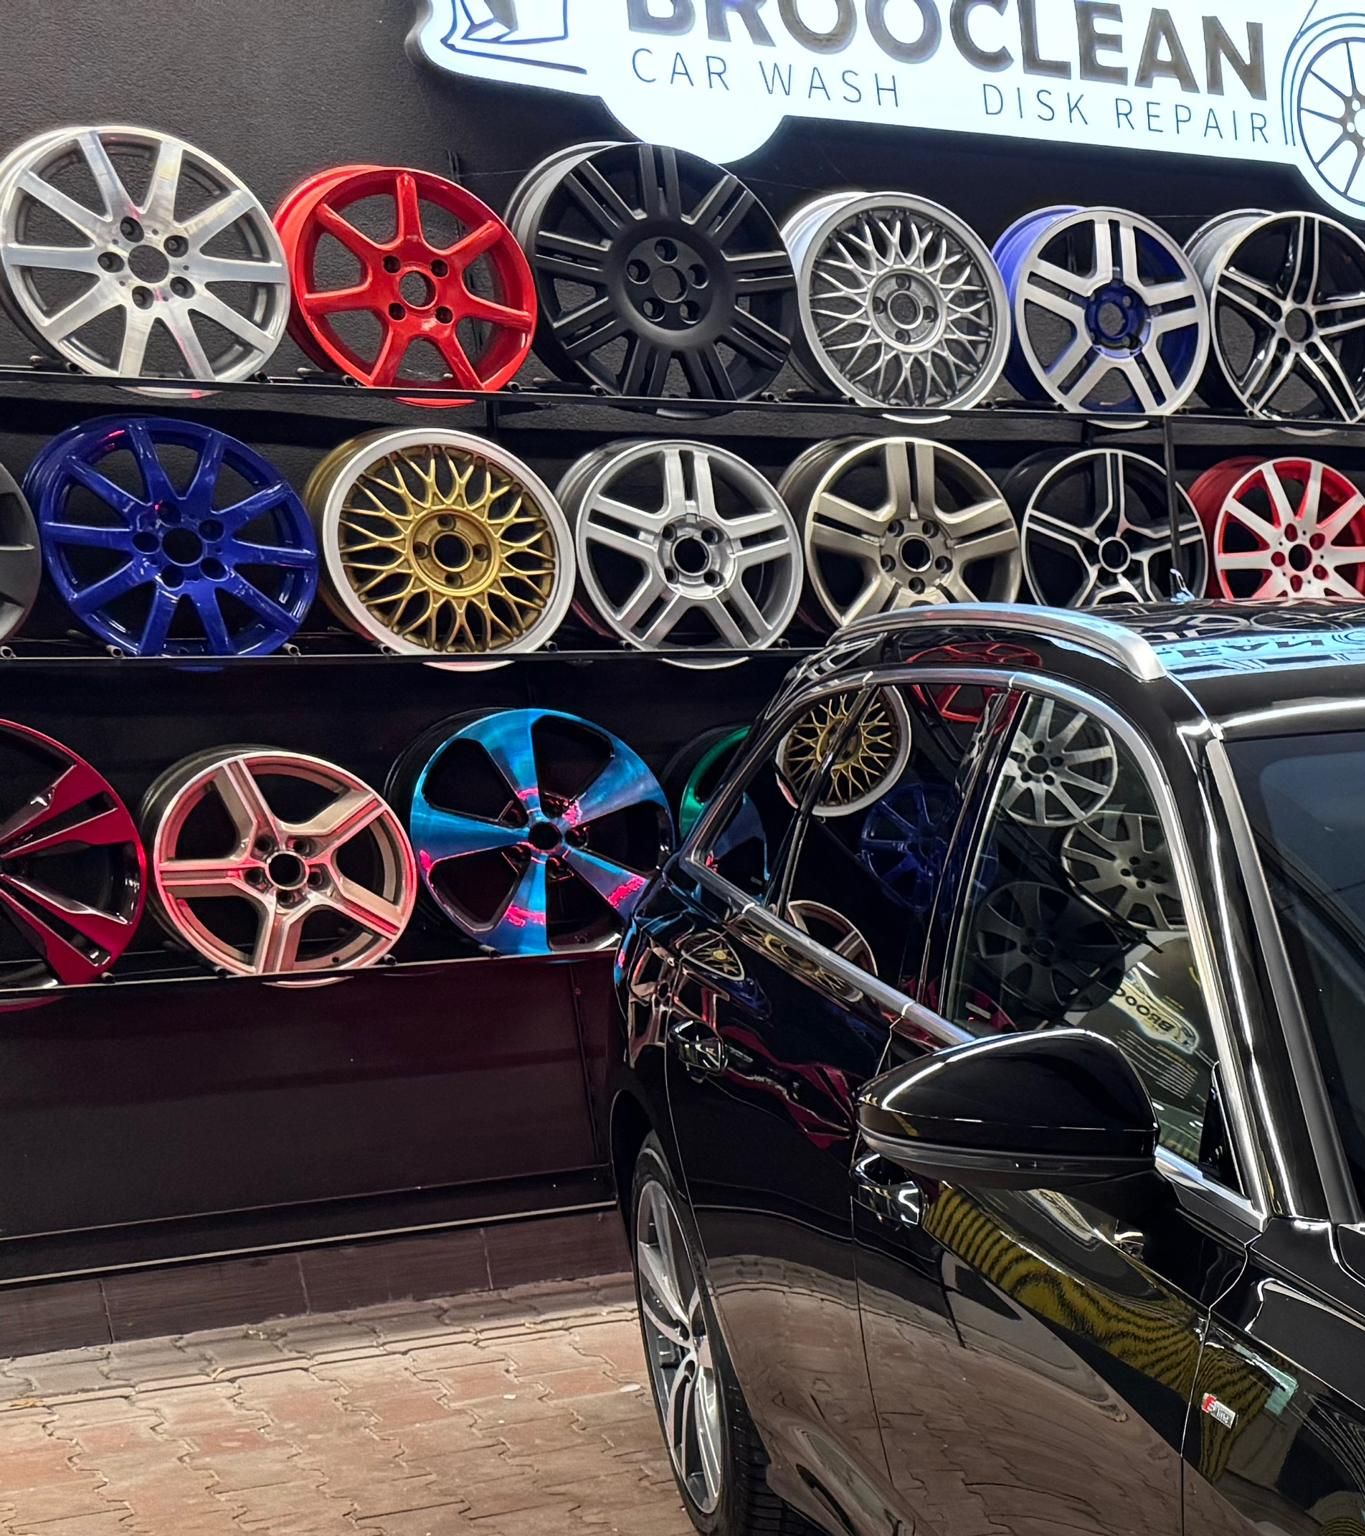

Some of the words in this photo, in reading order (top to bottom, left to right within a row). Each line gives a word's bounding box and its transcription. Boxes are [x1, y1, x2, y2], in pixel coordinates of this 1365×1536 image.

[632, 48, 729, 91] CAR
[759, 61, 898, 108] WASH
[983, 84, 1087, 125] DISK
[1115, 98, 1268, 144] REPAIR
